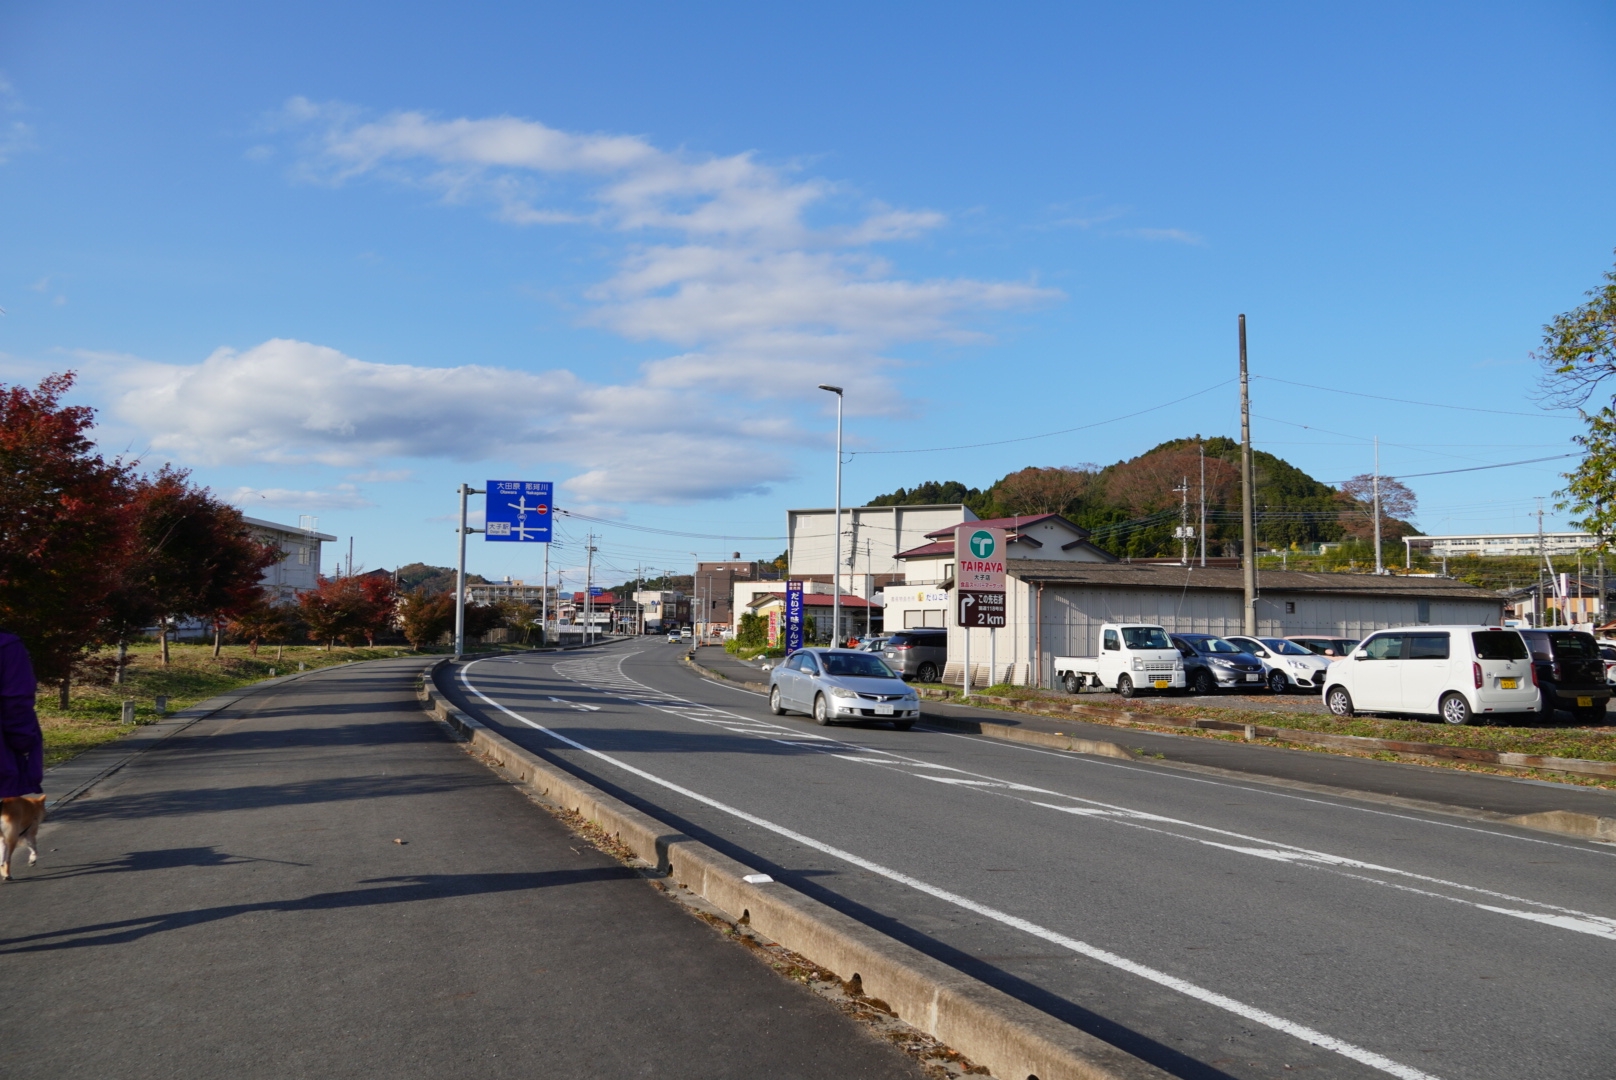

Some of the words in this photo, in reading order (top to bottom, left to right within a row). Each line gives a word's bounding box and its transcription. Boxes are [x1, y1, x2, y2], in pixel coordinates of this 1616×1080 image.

[497, 482, 520, 490] 大田原
[525, 483, 548, 491] 那珂川
[961, 561, 1003, 572] TAIRAYA
[960, 581, 1004, 589] 食品スーパーマーケット
[978, 594, 1004, 605] この先右折
[978, 613, 985, 624] 2
[987, 613, 1004, 625] km
